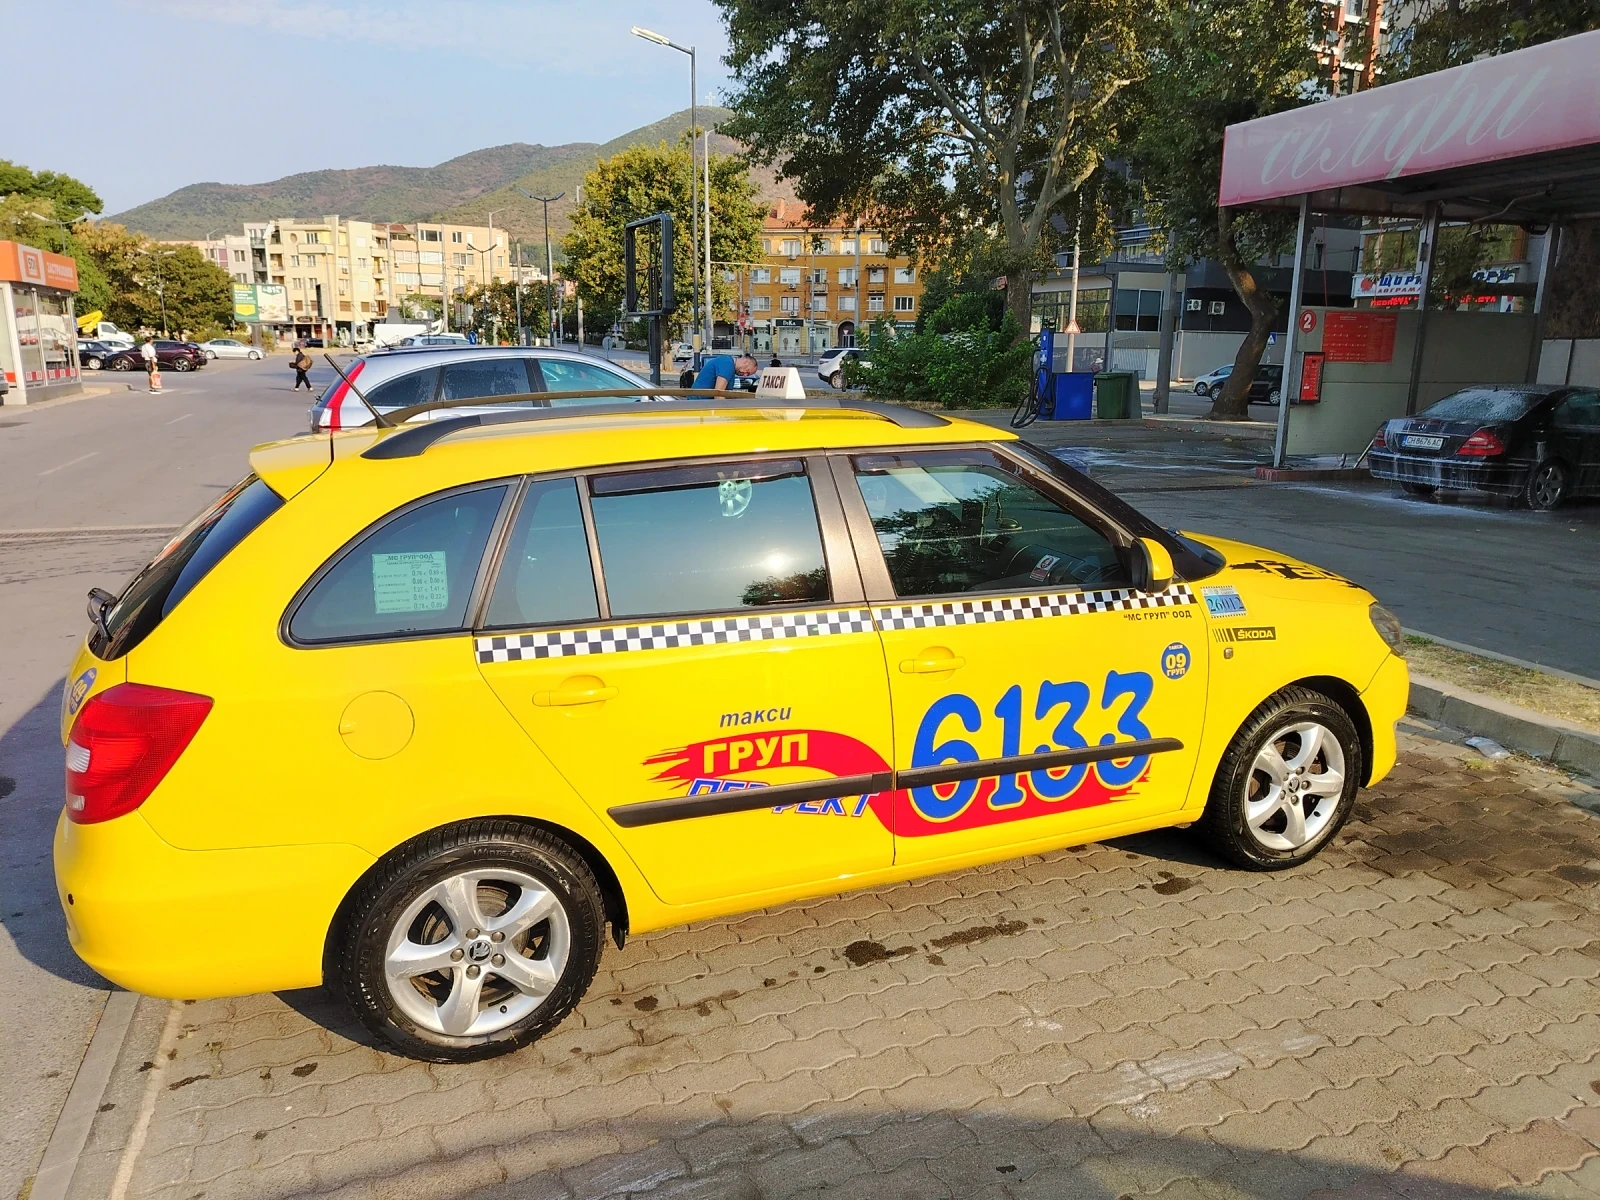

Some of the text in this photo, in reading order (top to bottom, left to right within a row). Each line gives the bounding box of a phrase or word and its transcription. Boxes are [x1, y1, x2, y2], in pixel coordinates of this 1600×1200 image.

[1303, 313, 1312, 329] 2
[762, 375, 786, 389] ТАКСИ
[1172, 610, 1192, 619] ООД
[1237, 629, 1274, 640] ŠKODA
[1165, 652, 1187, 670] 09
[1166, 667, 1186, 677] ГРУП
[719, 706, 792, 728] такси
[703, 733, 808, 774] ГРУП
[909, 670, 1155, 822] 6133
